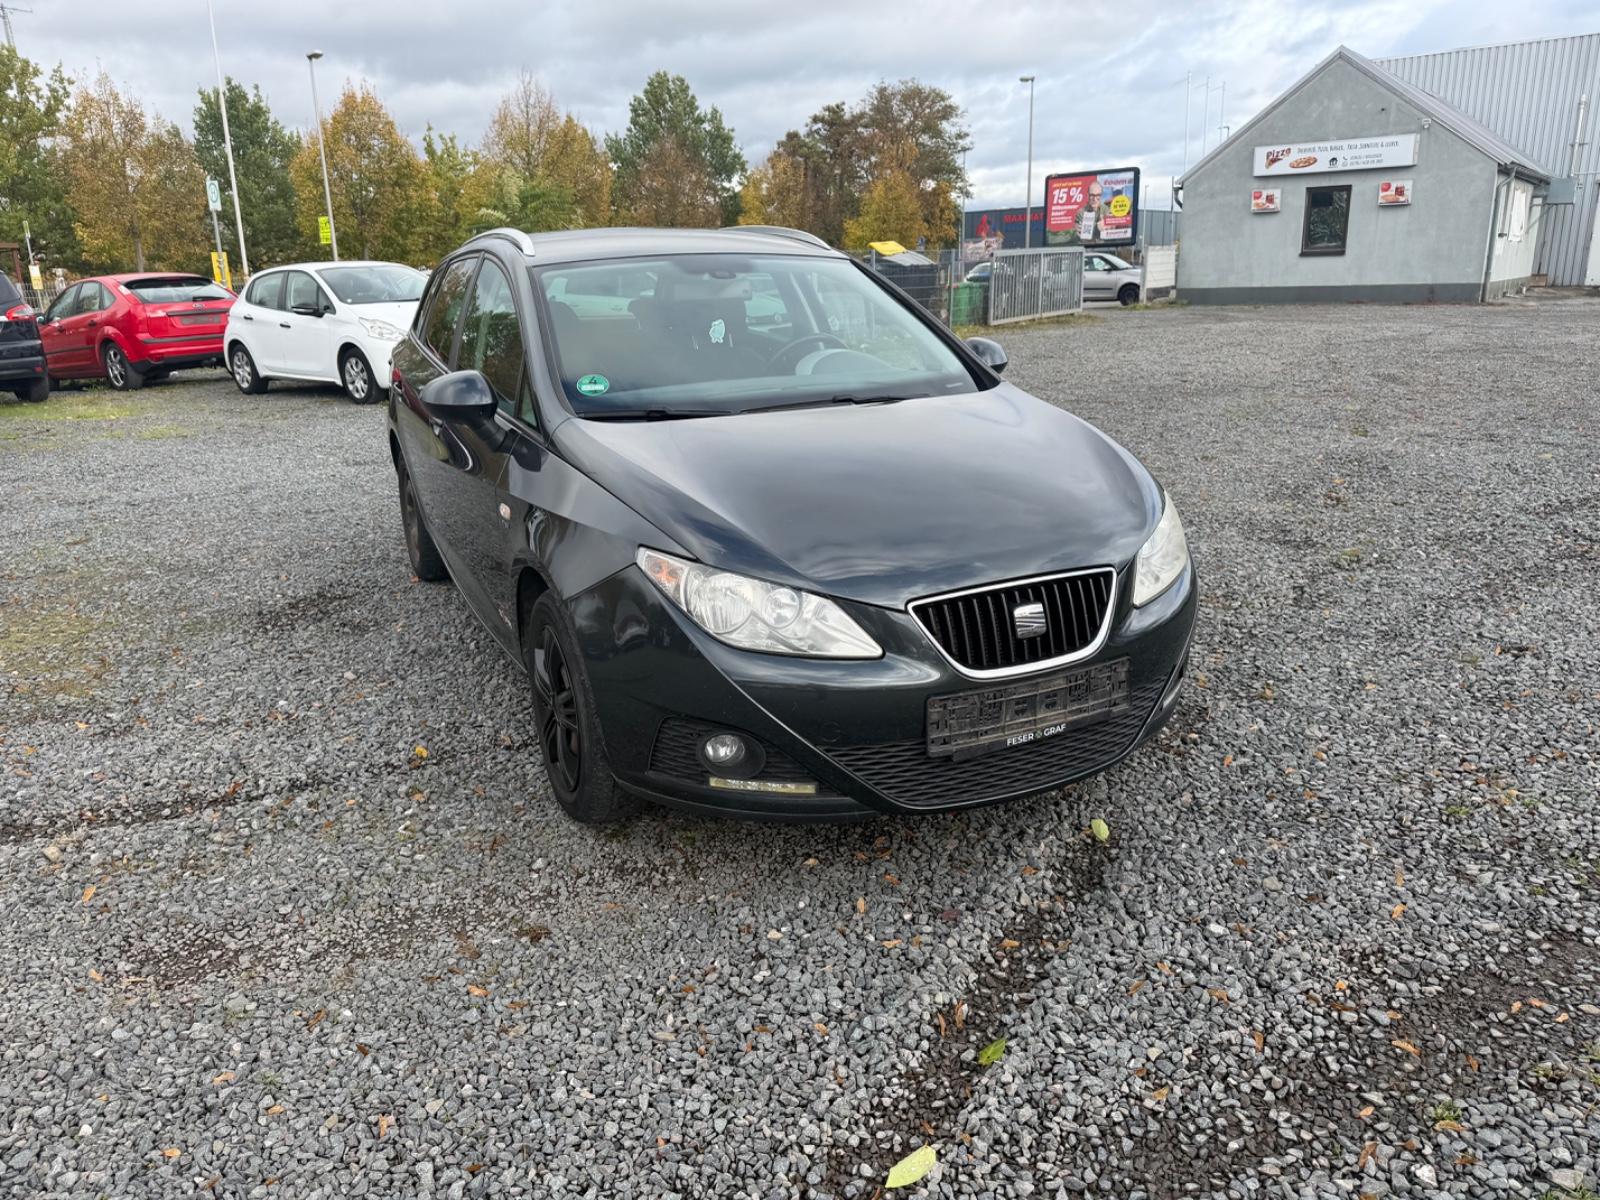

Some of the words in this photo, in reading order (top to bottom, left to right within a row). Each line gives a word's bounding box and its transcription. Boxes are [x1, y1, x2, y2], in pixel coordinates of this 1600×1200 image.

[1053, 188, 1068, 204] 15
[1070, 187, 1083, 203] %
[1003, 212, 1044, 223] MAXIAT
[588, 376, 598, 384] 4
[1007, 733, 1034, 746] FESER
[1044, 723, 1067, 736] GRAF
